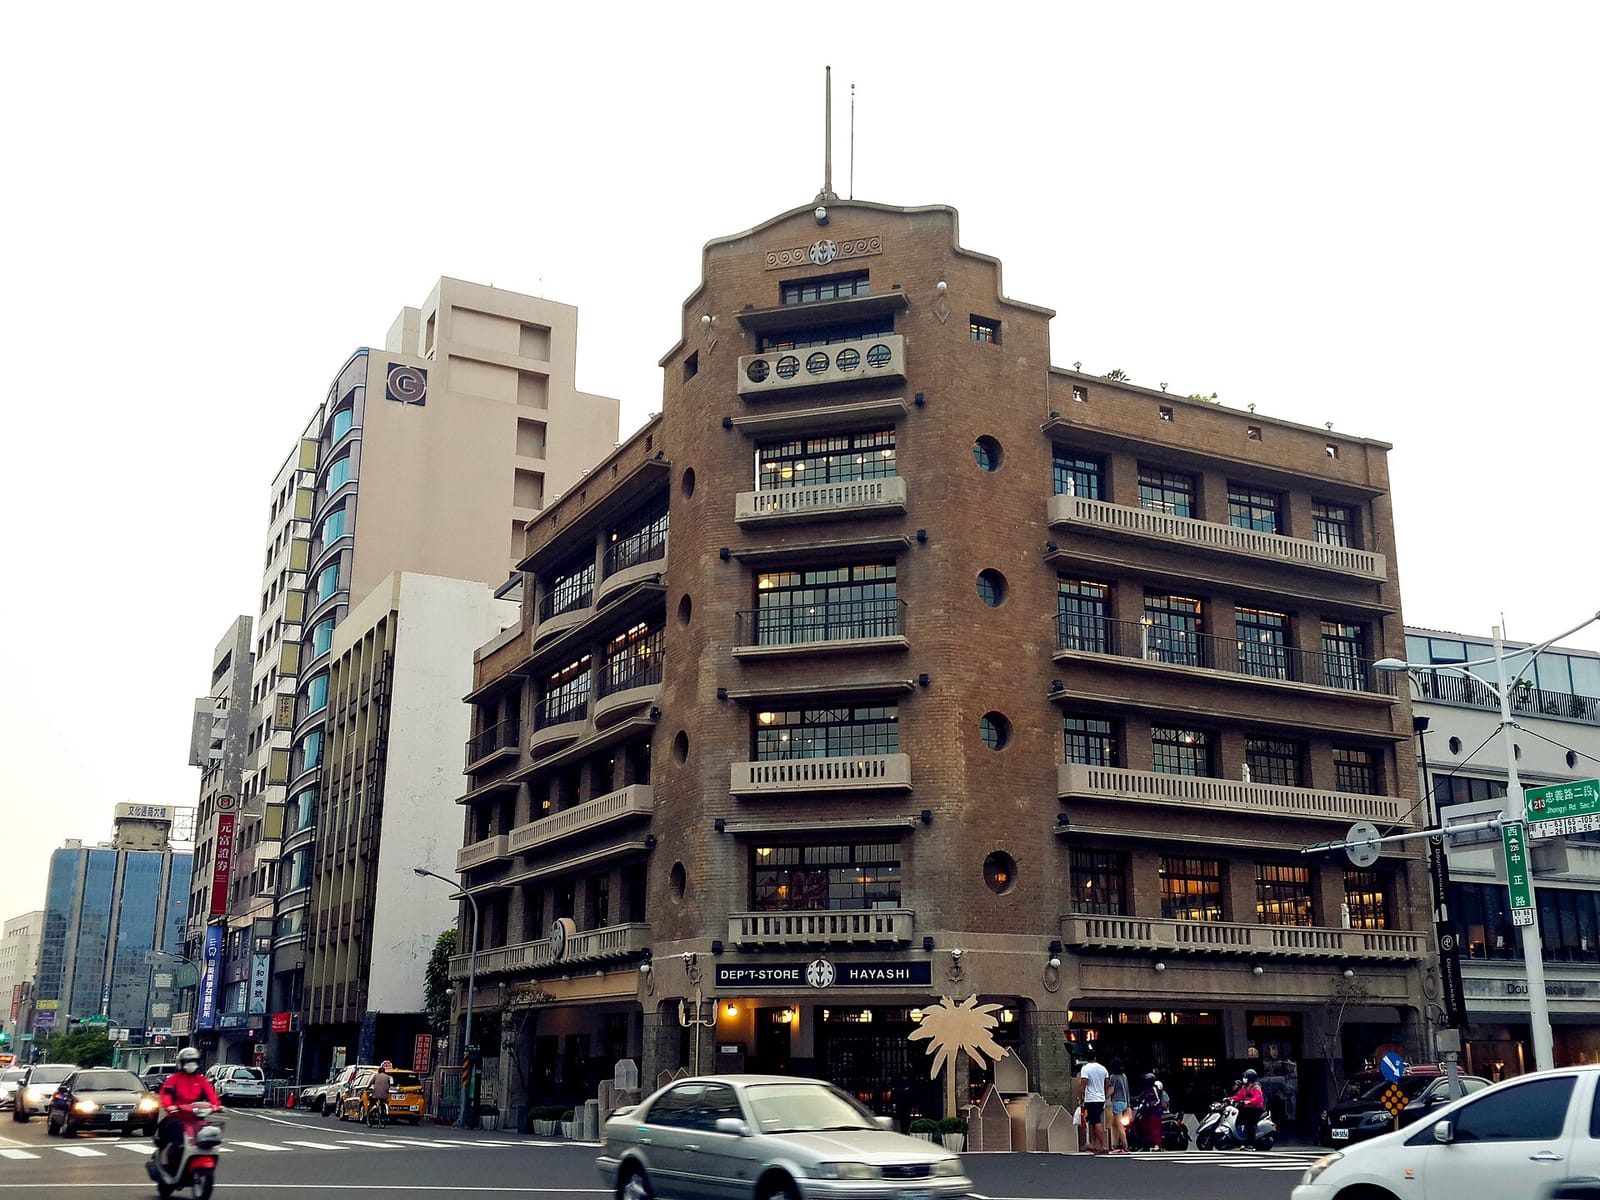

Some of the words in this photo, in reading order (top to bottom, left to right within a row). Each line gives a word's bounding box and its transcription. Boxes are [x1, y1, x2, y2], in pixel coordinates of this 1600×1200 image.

[1545, 785, 1593, 803] 忠義路二段
[1533, 799, 1546, 810] 213
[1511, 853, 1526, 906] 中正路
[849, 968, 911, 980] HAYASHI
